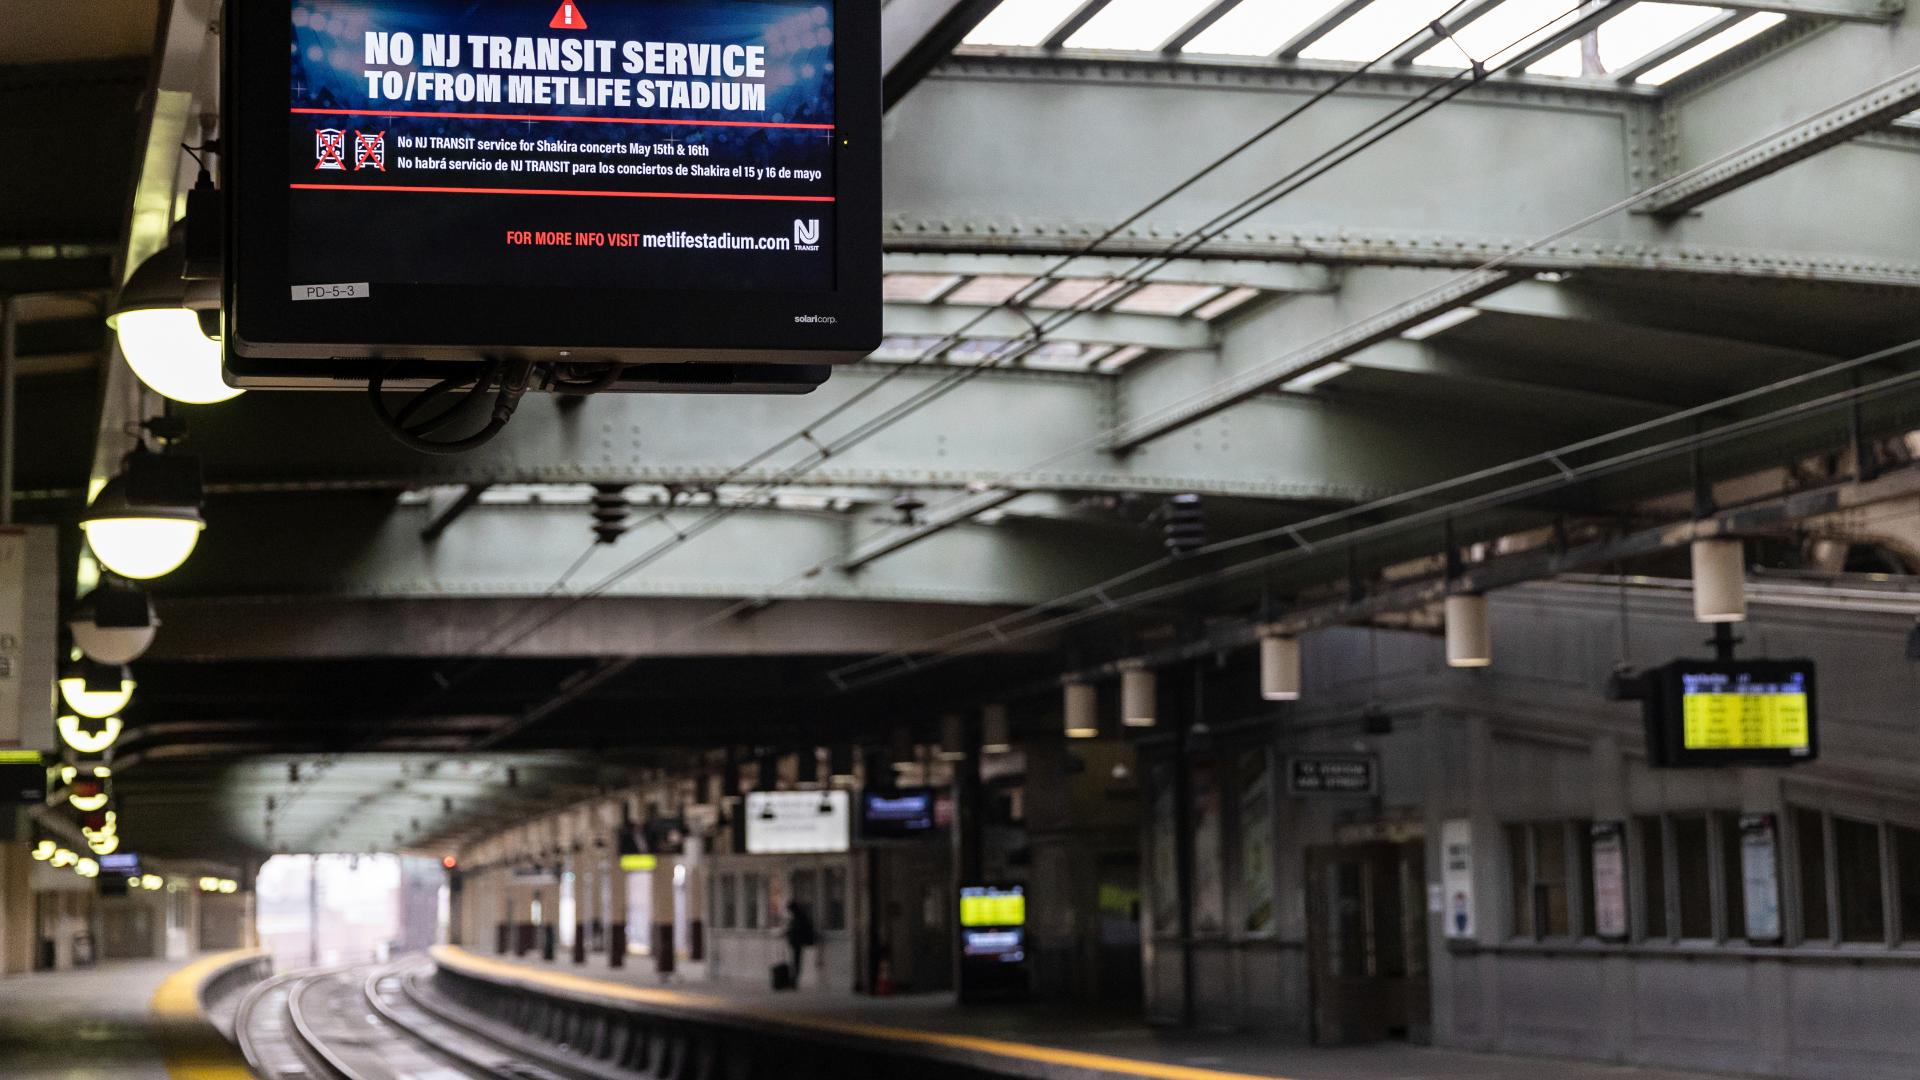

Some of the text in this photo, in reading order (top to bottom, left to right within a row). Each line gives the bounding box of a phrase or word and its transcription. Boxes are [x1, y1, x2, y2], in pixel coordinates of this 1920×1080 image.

[365, 31, 765, 78] NO NJ TRANSIT SERVICE
[364, 70, 766, 111] TO/FROM METLIFE STADIUM
[398, 136, 709, 157] No NJ TRANSIT service for Shakira concerts May 15th & 16th
[398, 157, 822, 181] No habrá servicio de NJ TRANSIT para los conciertos de Shakira el 15 y 16 de mayo
[507, 231, 789, 250] FOR MORE INFO VISIT metlifestadium.com
[307, 285, 355, 298] PD-5-3
